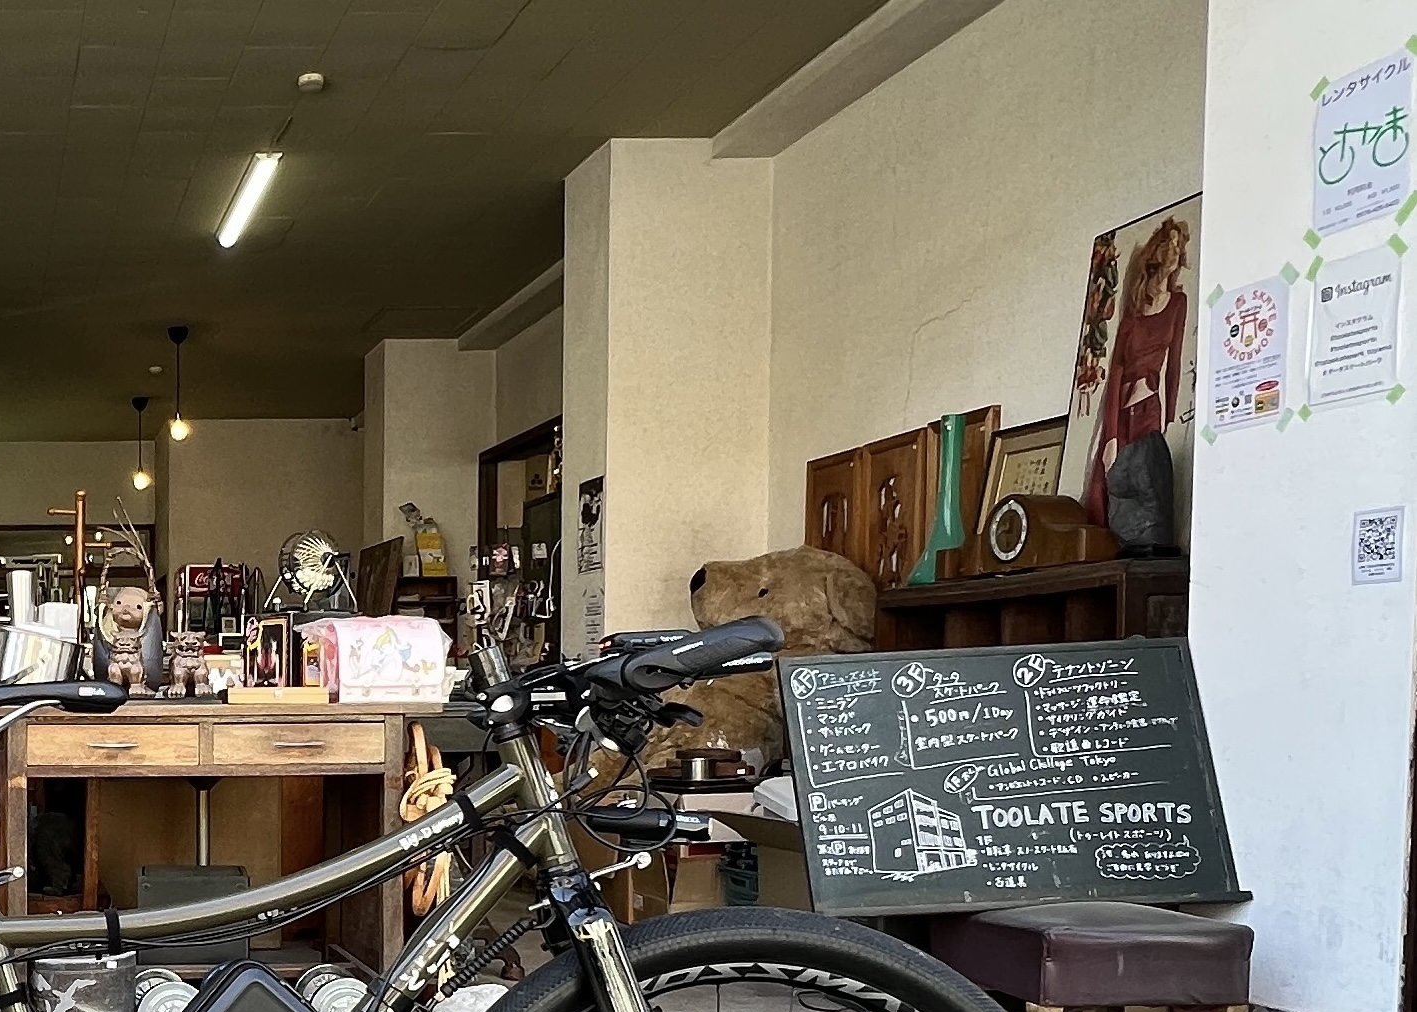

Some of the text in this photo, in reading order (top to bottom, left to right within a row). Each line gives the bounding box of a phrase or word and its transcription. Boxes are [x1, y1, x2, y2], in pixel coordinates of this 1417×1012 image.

[1321, 57, 1412, 107] レンタサイクル
[1335, 273, 1392, 299] Instagram
[792, 669, 812, 695] 4F
[897, 664, 924, 693] 3F
[987, 759, 1026, 777] Global
[1080, 755, 1116, 767] Tokyo
[971, 801, 1192, 830] TOOLATE SPORTS
